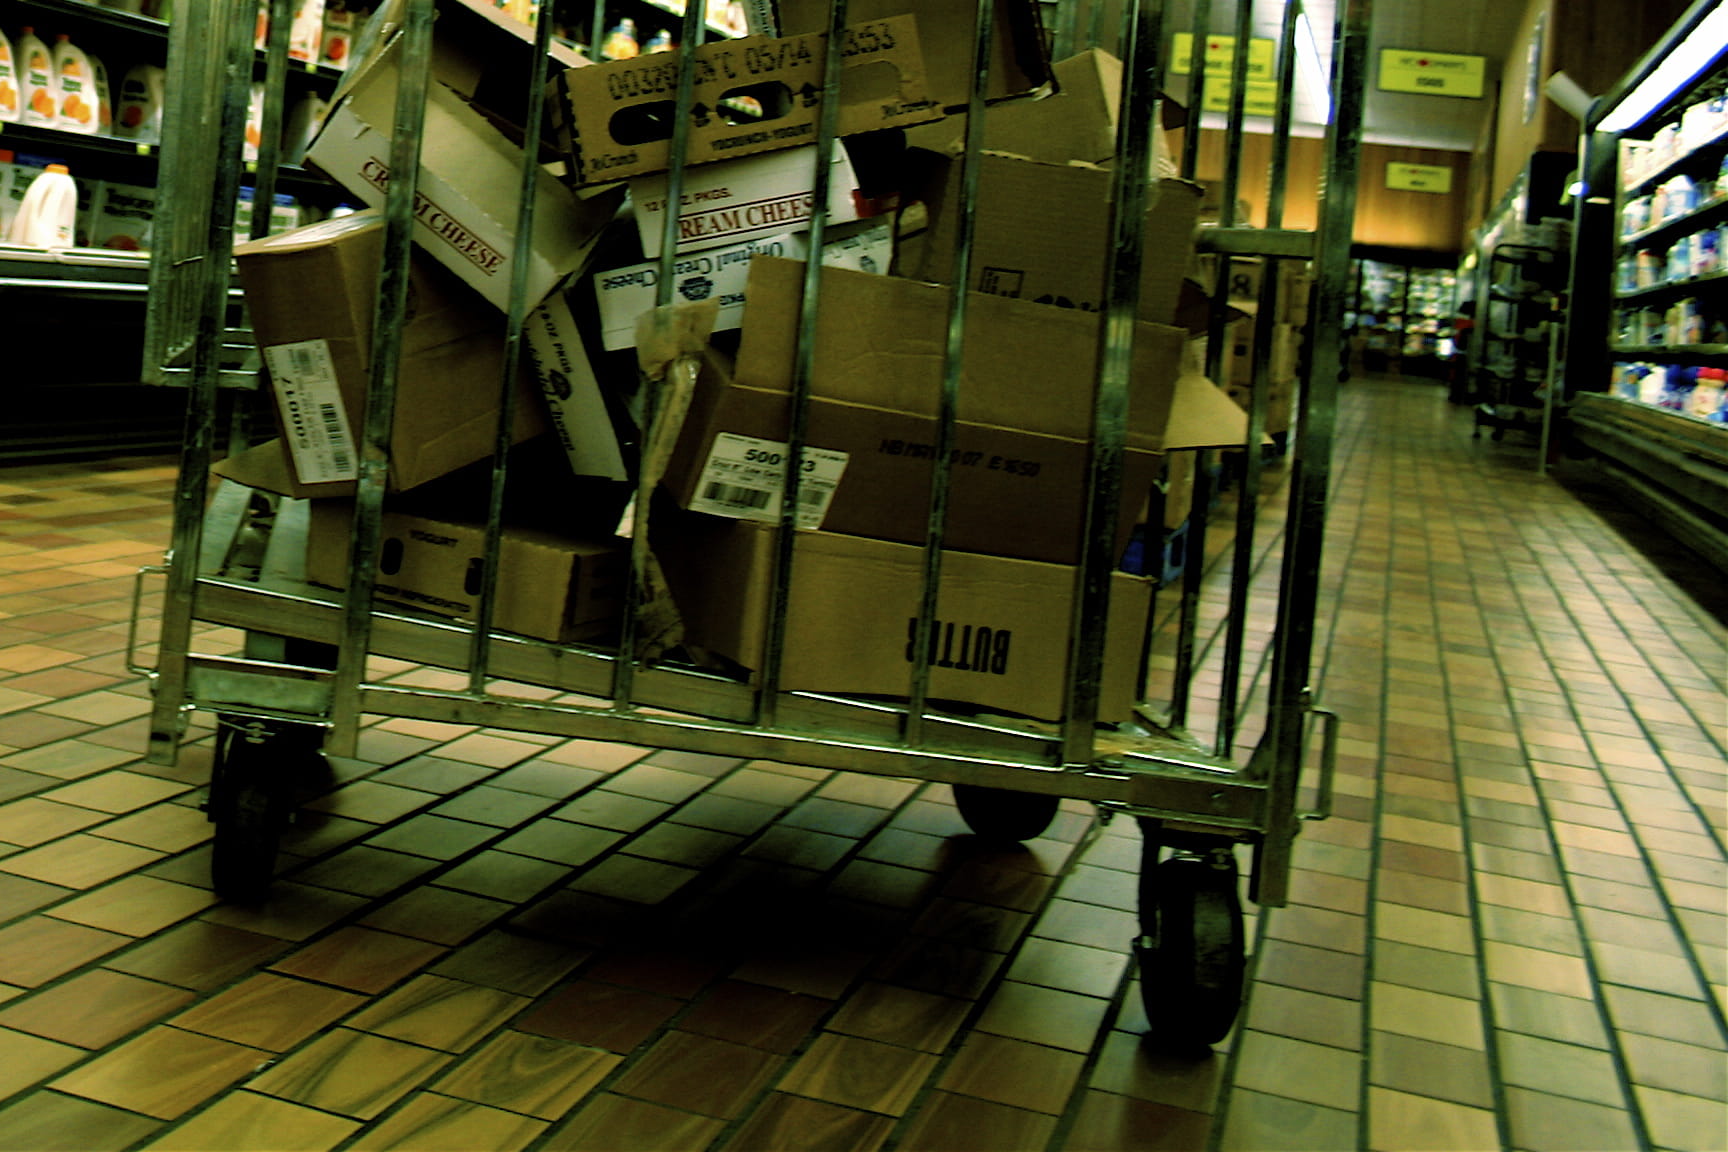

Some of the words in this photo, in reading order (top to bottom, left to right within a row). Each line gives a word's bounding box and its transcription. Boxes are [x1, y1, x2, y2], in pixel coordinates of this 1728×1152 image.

[678, 210, 741, 241] REAM
[746, 196, 817, 228] CHEES
[430, 212, 504, 274] CHEESE
[603, 268, 659, 292] Cheese
[671, 256, 712, 277] Crea
